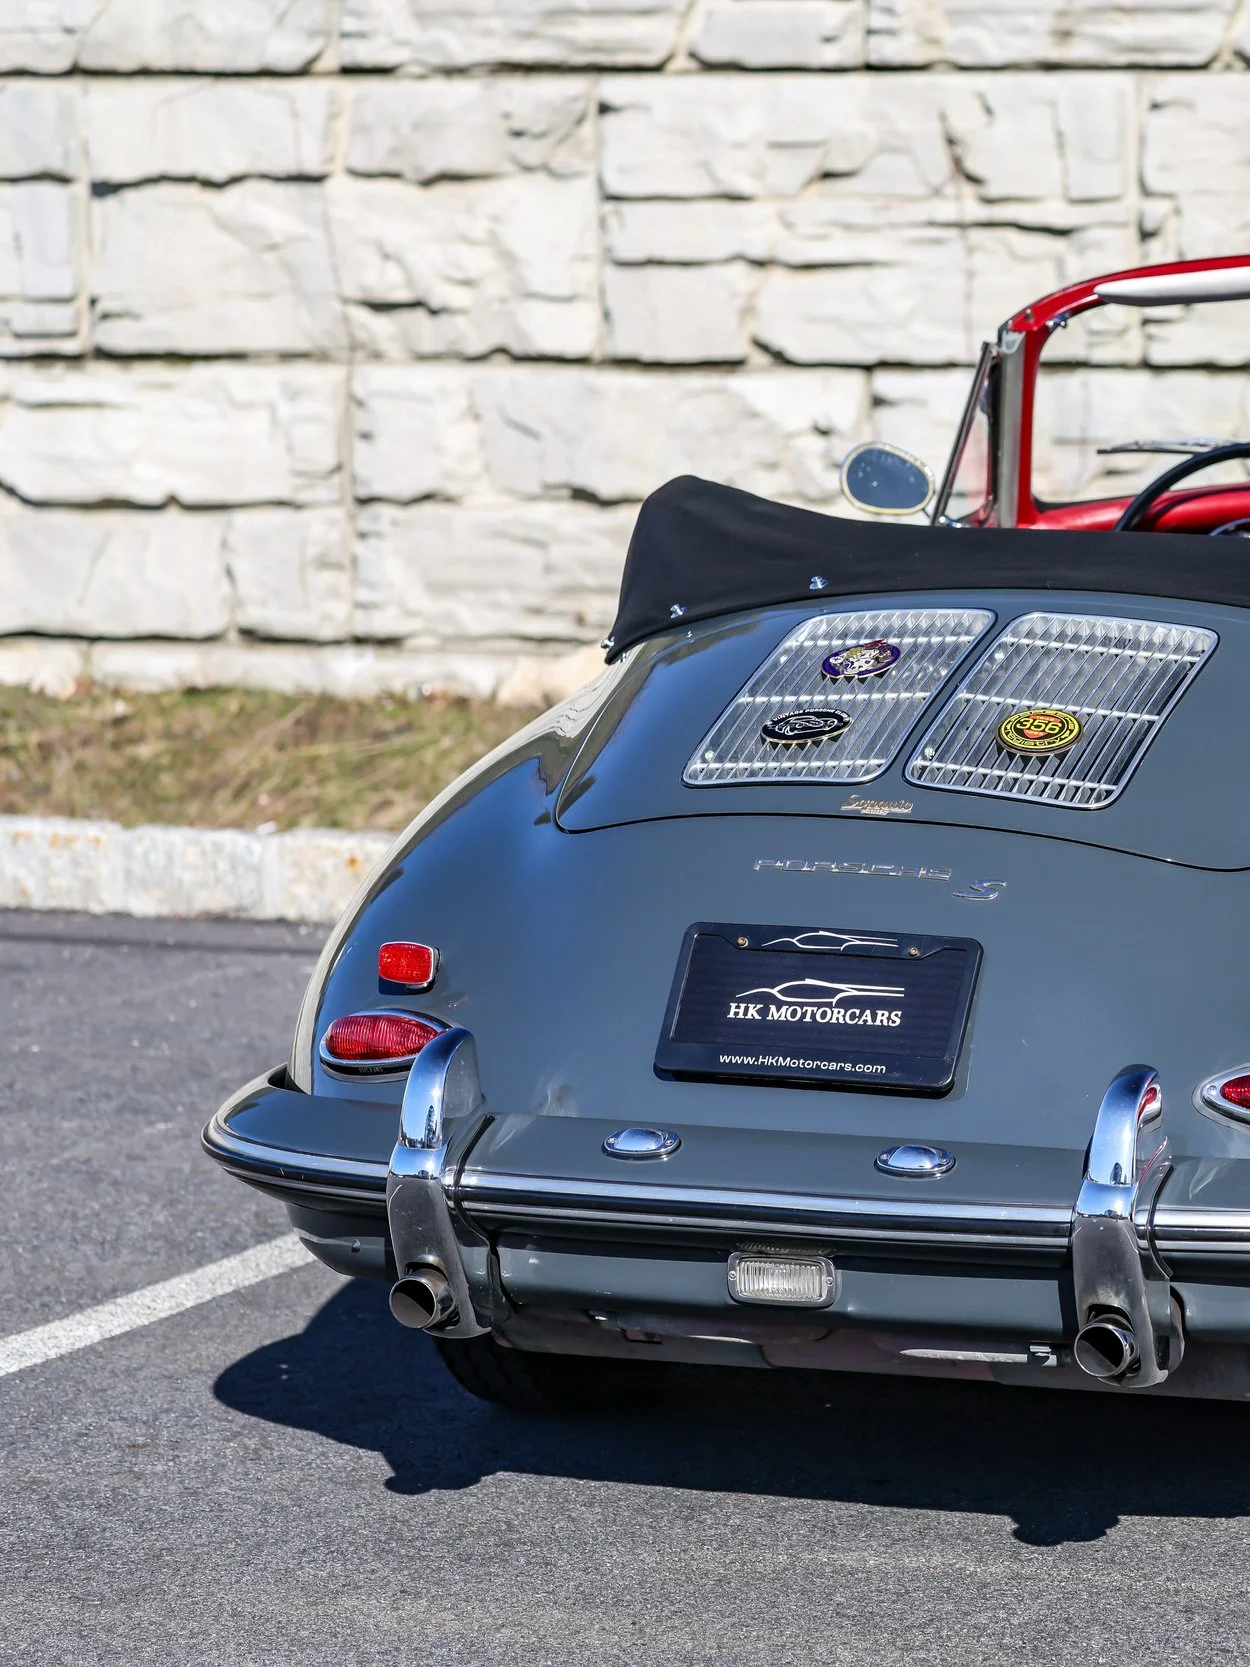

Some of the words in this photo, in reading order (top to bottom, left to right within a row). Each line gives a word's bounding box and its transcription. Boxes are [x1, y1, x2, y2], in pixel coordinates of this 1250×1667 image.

[1016, 717, 1063, 734] 356
[753, 858, 952, 882] PORSCHE
[952, 879, 1007, 900] S
[727, 1003, 763, 1020] HK
[766, 1005, 902, 1026] MOTORCARS
[719, 1054, 886, 1074] www.HKMotorcars.com
